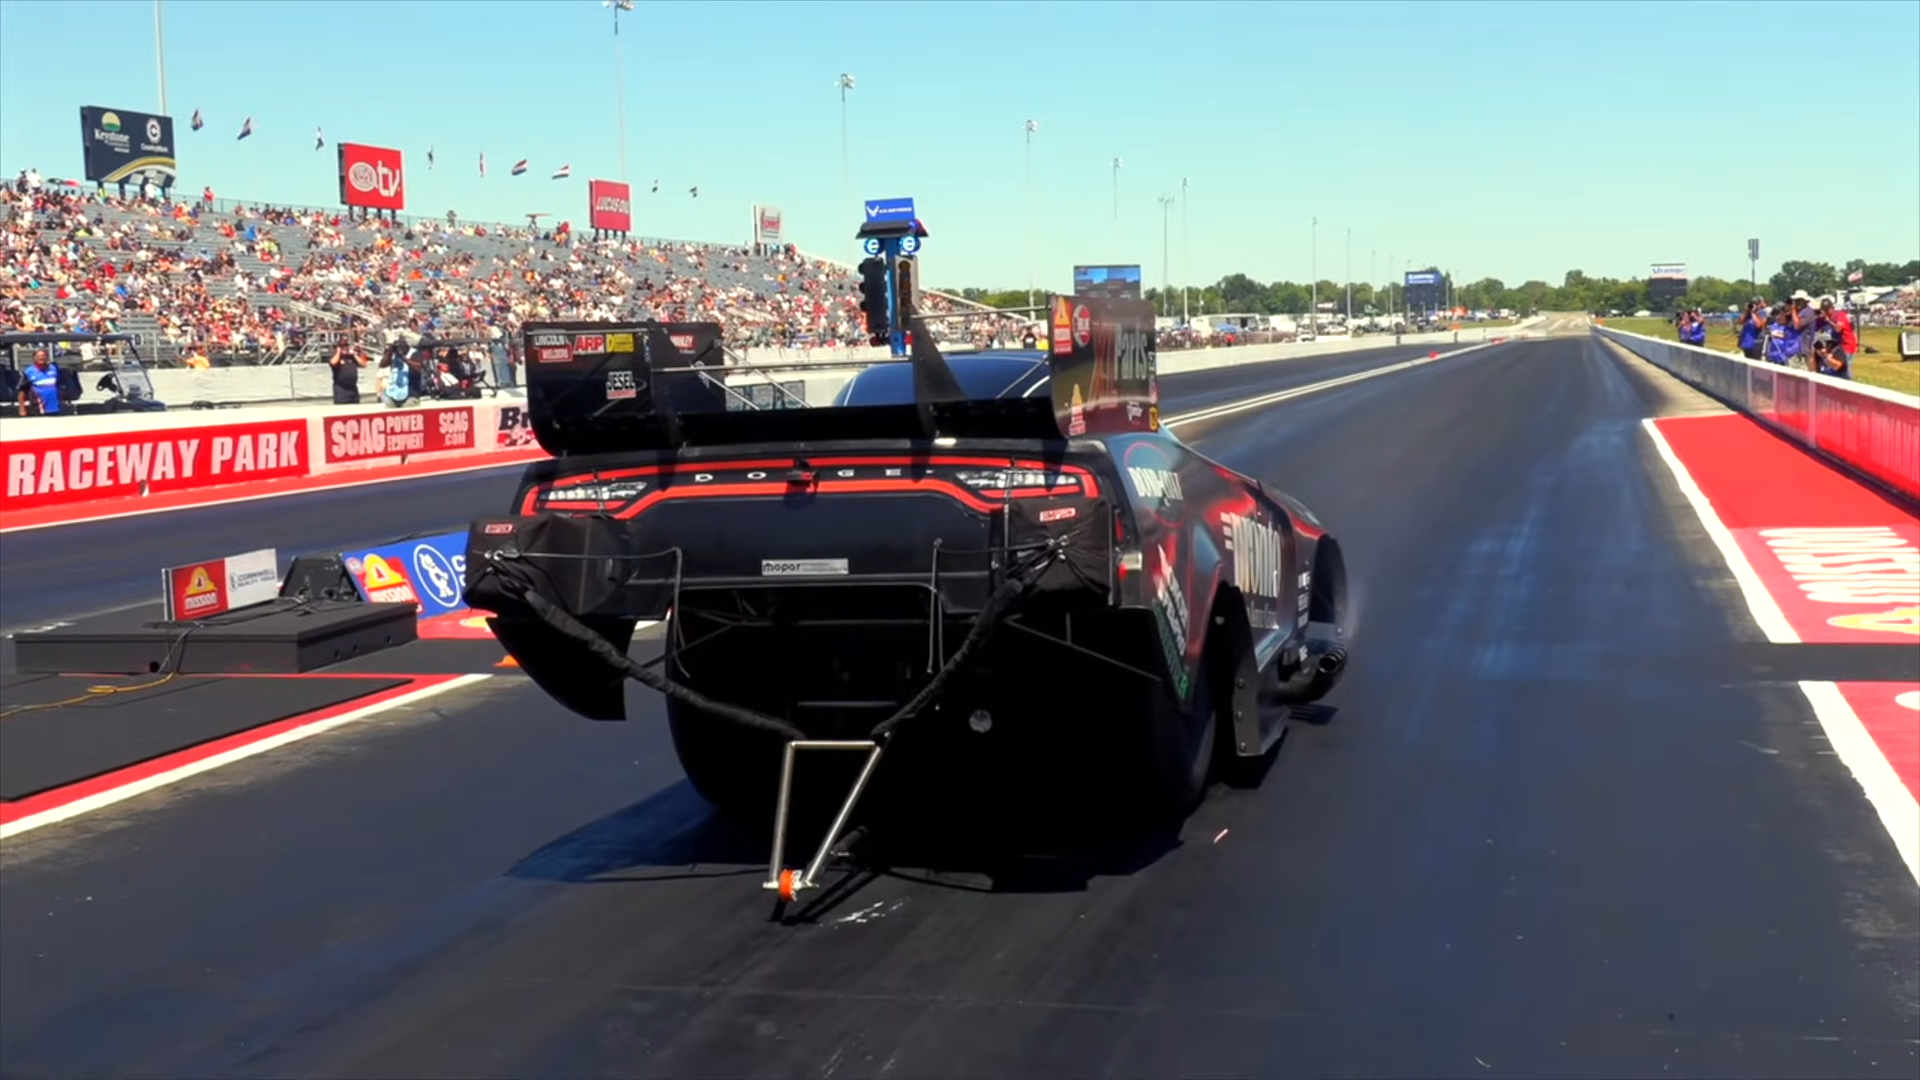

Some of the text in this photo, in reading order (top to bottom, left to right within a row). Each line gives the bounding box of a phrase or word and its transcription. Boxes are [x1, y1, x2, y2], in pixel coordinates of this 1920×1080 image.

[377, 160, 400, 197] tv
[576, 335, 602, 351] ARP
[607, 372, 635, 391] JESEL
[439, 411, 468, 434] SCAG
[331, 414, 424, 458] SCAG POWER
[7, 430, 299, 498] RACEWAY PARK
[694, 468, 901, 482] DOGE
[763, 562, 801, 572] mopar
